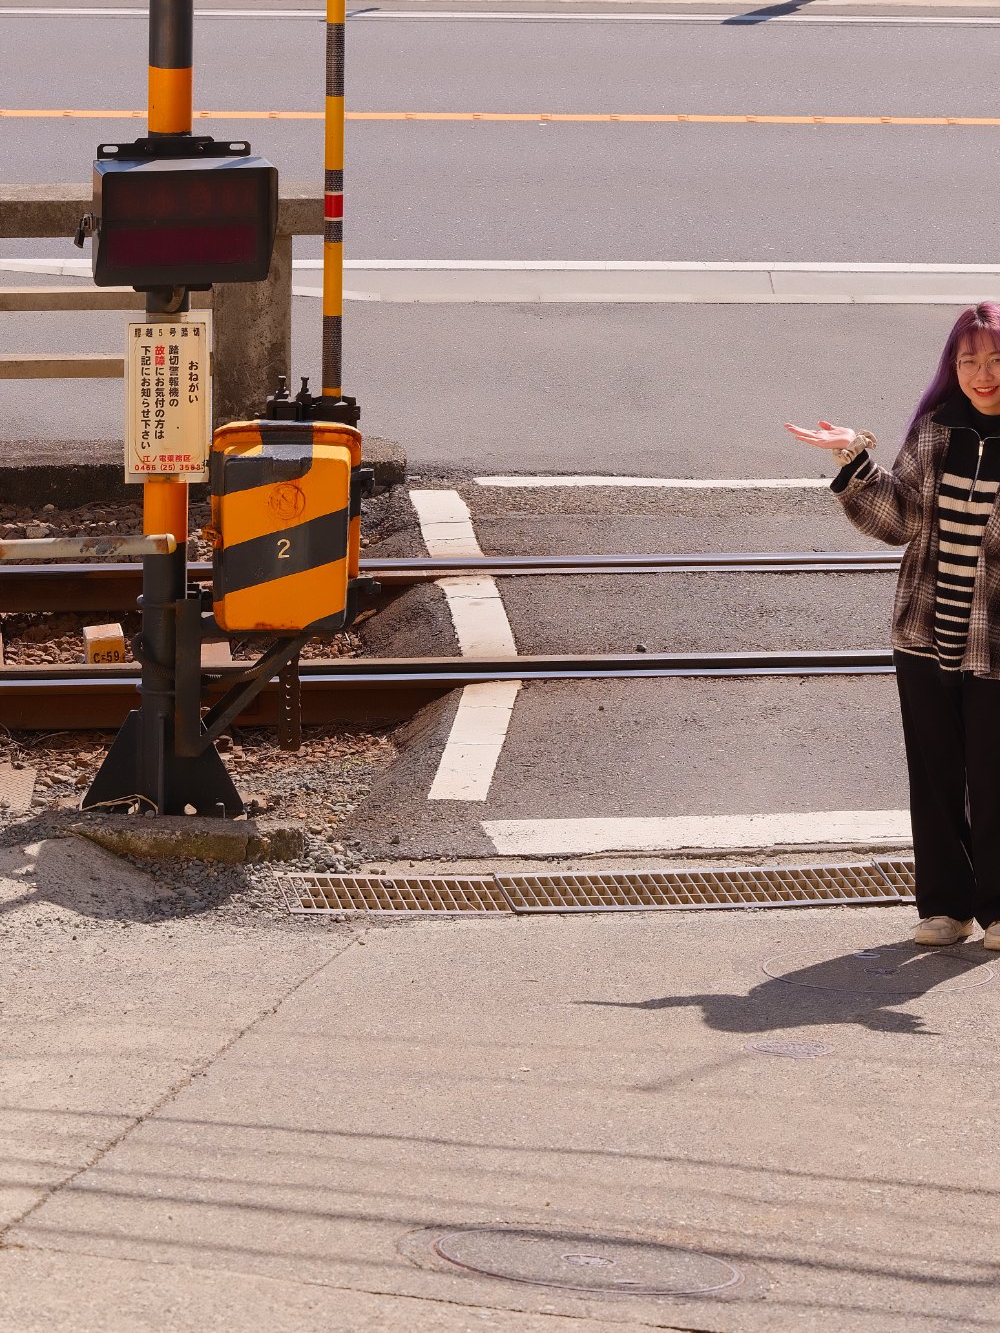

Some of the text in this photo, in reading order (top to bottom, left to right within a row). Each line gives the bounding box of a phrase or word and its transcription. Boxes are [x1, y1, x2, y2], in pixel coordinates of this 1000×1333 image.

[140, 346, 150, 449] 下記にお知らせ下さい
[155, 345, 165, 439] 故障にお気付の方は
[169, 345, 179, 407] 踏切警報機の
[188, 361, 199, 404] おねがい
[277, 538, 290, 559] 2
